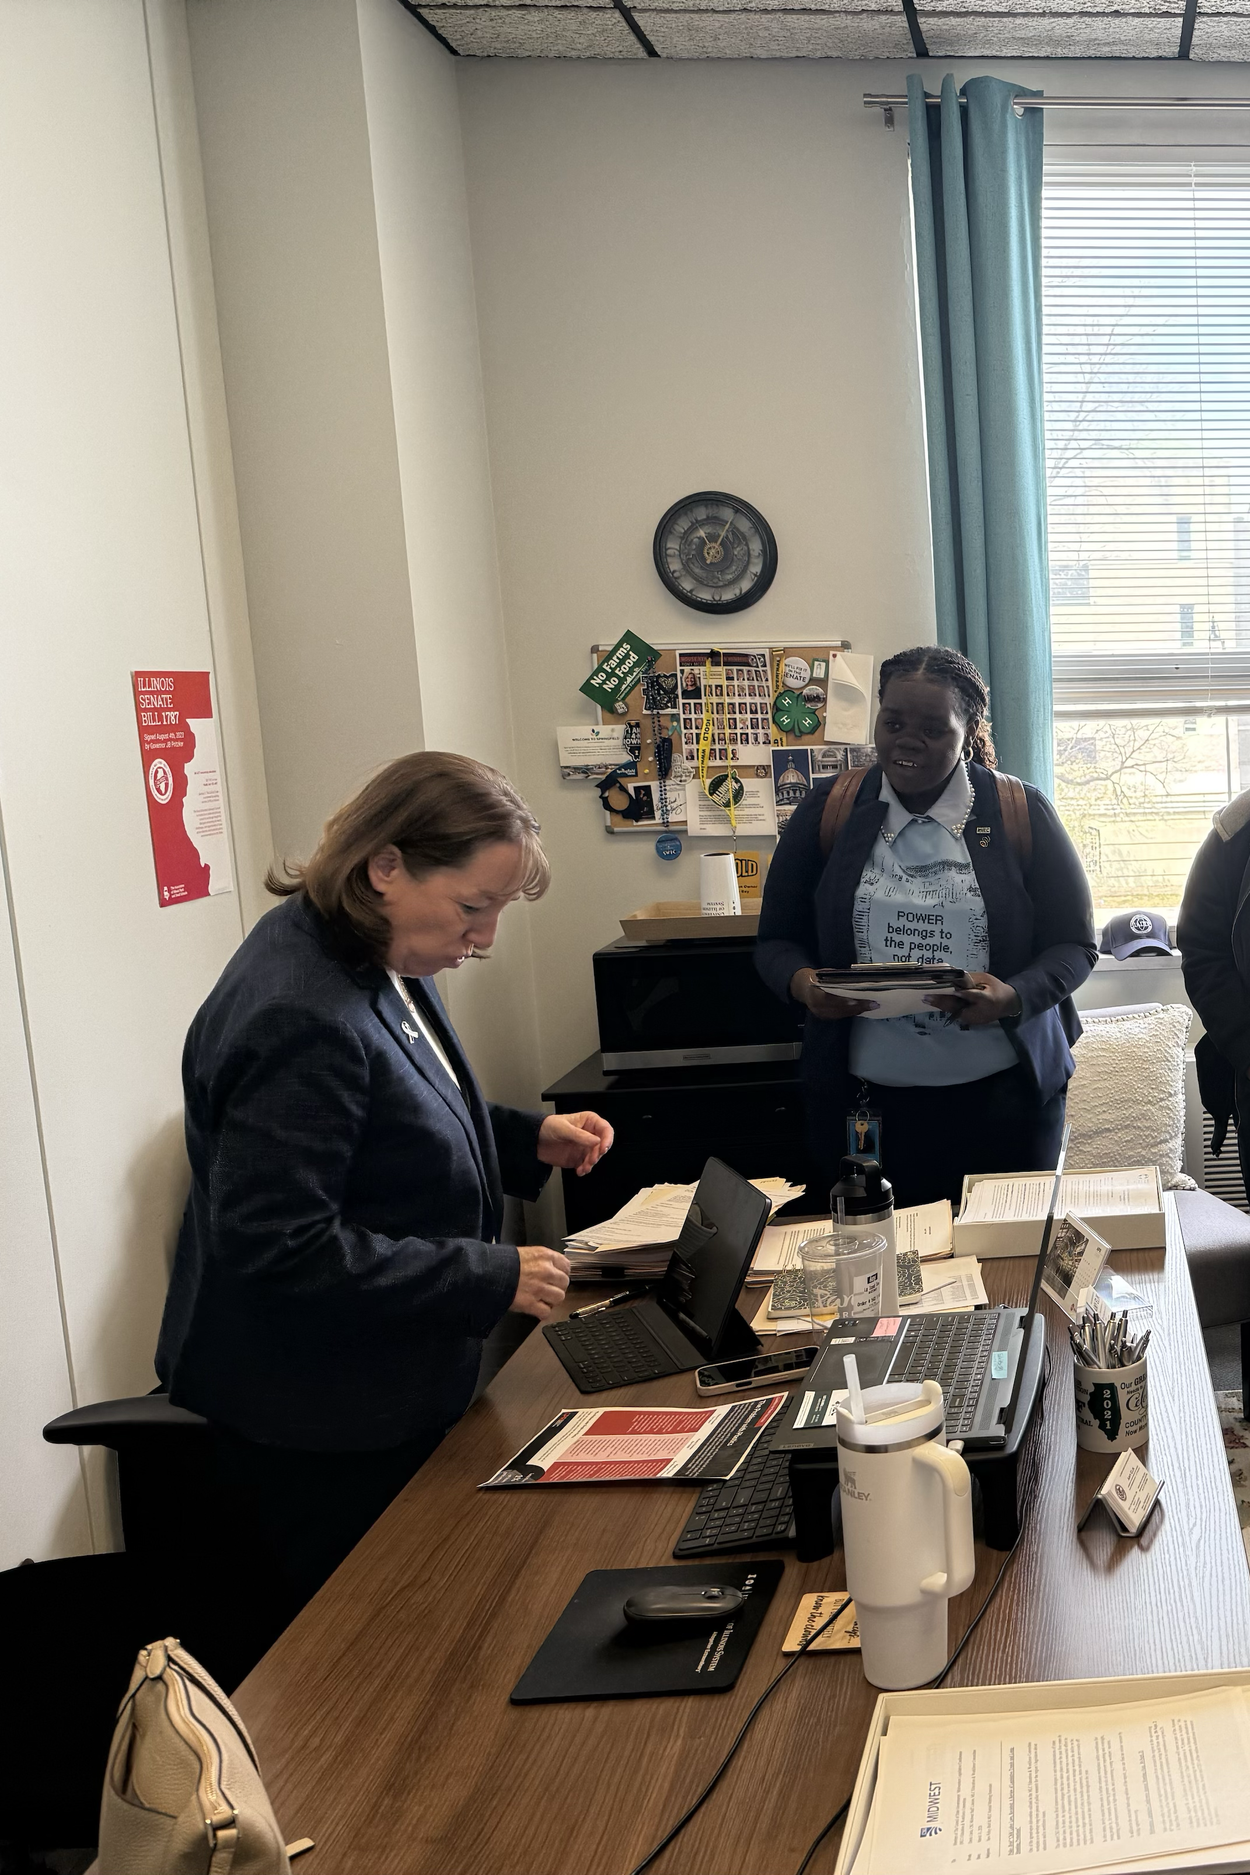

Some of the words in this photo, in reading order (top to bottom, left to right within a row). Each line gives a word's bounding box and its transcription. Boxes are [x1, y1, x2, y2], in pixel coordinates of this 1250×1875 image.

[590, 672, 606, 687] No
[602, 642, 631, 672] Farms
[602, 676, 618, 692] No
[615, 651, 639, 677] Food
[784, 671, 806, 682] SENATE
[138, 678, 174, 691] ILLINOIS
[140, 695, 173, 708] SENATE
[141, 712, 161, 725] BILL
[162, 712, 179, 724] 1787
[735, 858, 758, 878] OLD
[897, 910, 944, 925] POWER
[887, 923, 935, 940] belongs
[940, 927, 952, 940] to
[884, 938, 904, 949] the
[909, 941, 953, 954] people,
[893, 952, 912, 963] not
[812, 1595, 830, 1610] know
[806, 1611, 824, 1623] the
[926, 1781, 942, 1823] MIDWEST
